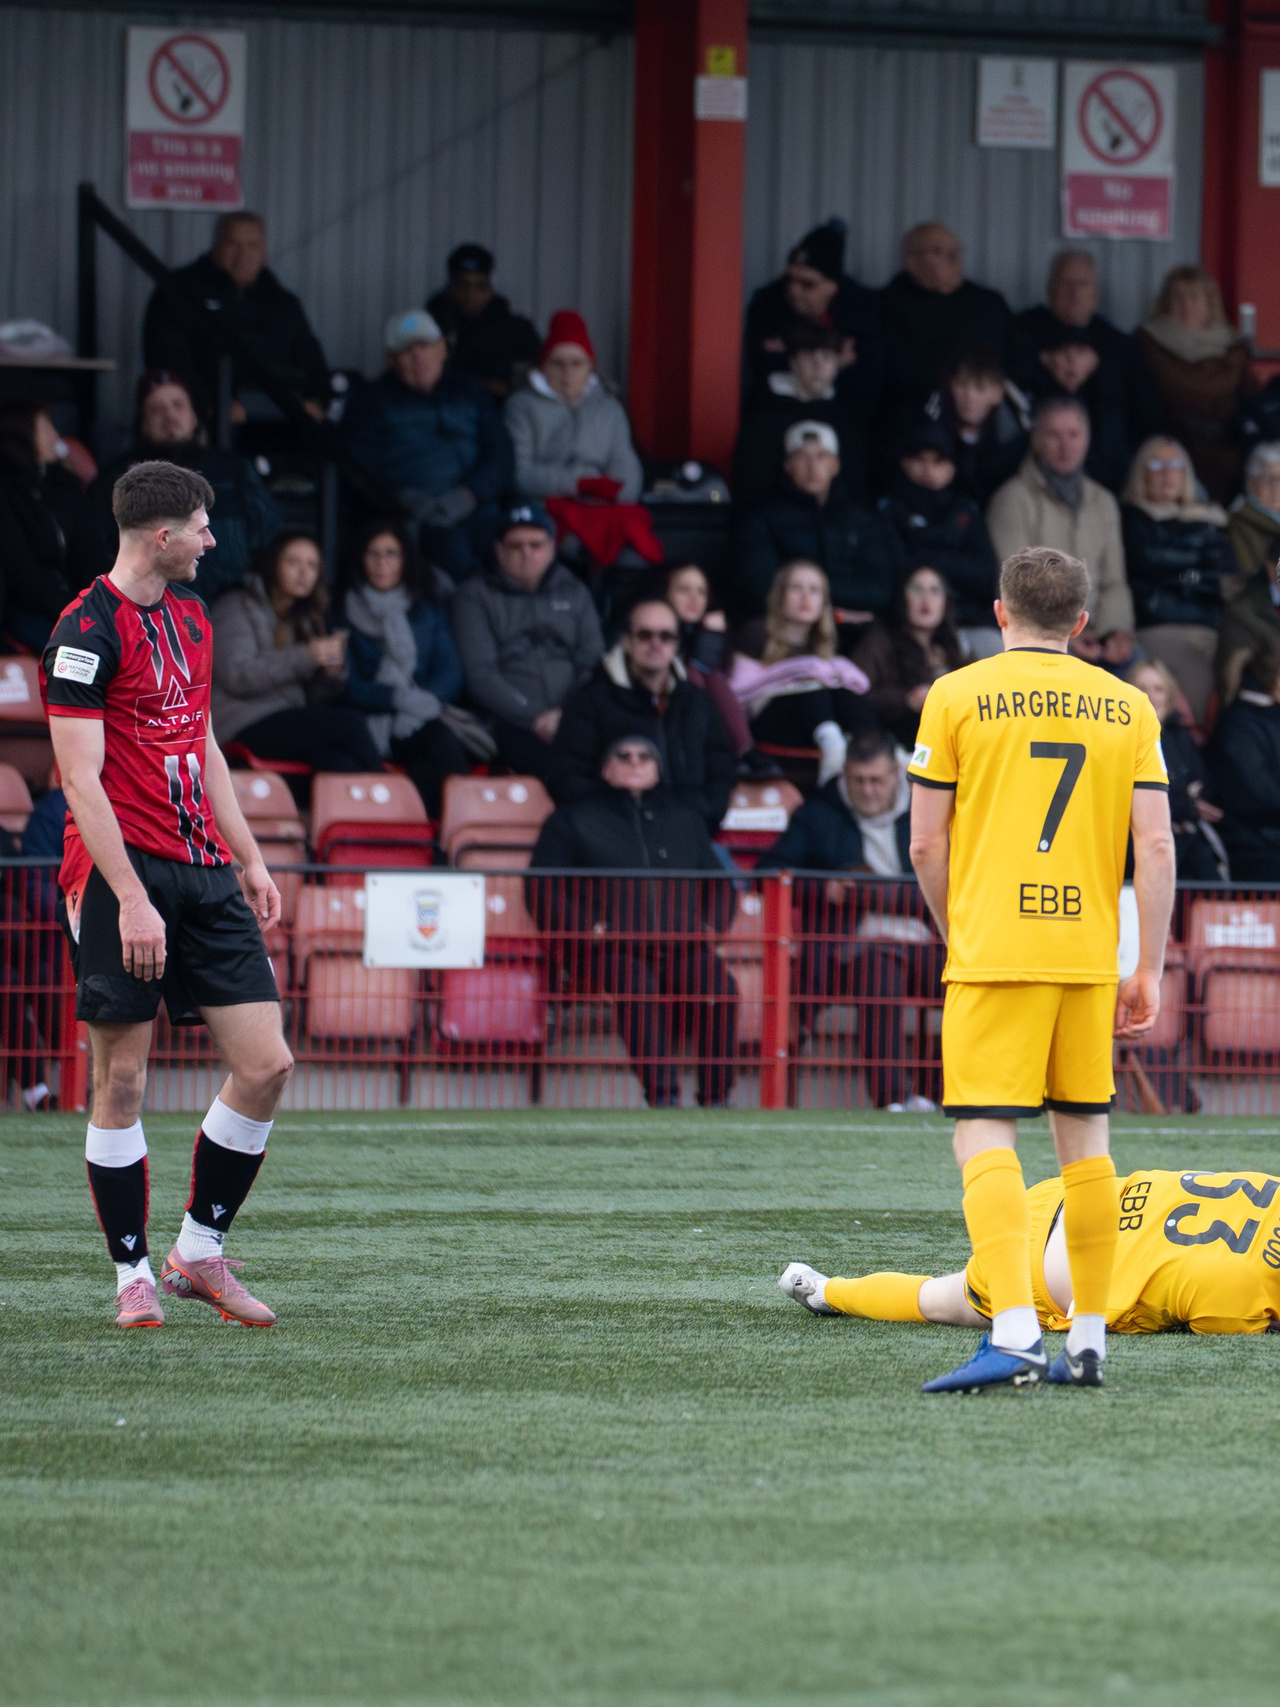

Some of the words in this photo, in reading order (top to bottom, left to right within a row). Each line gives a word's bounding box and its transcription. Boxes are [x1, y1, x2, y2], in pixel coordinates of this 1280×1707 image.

[977, 690, 1132, 726] HARGREAVES
[1029, 741, 1087, 853] 7
[1018, 882, 1083, 917] EBB
[1118, 1180, 1153, 1232] EBB
